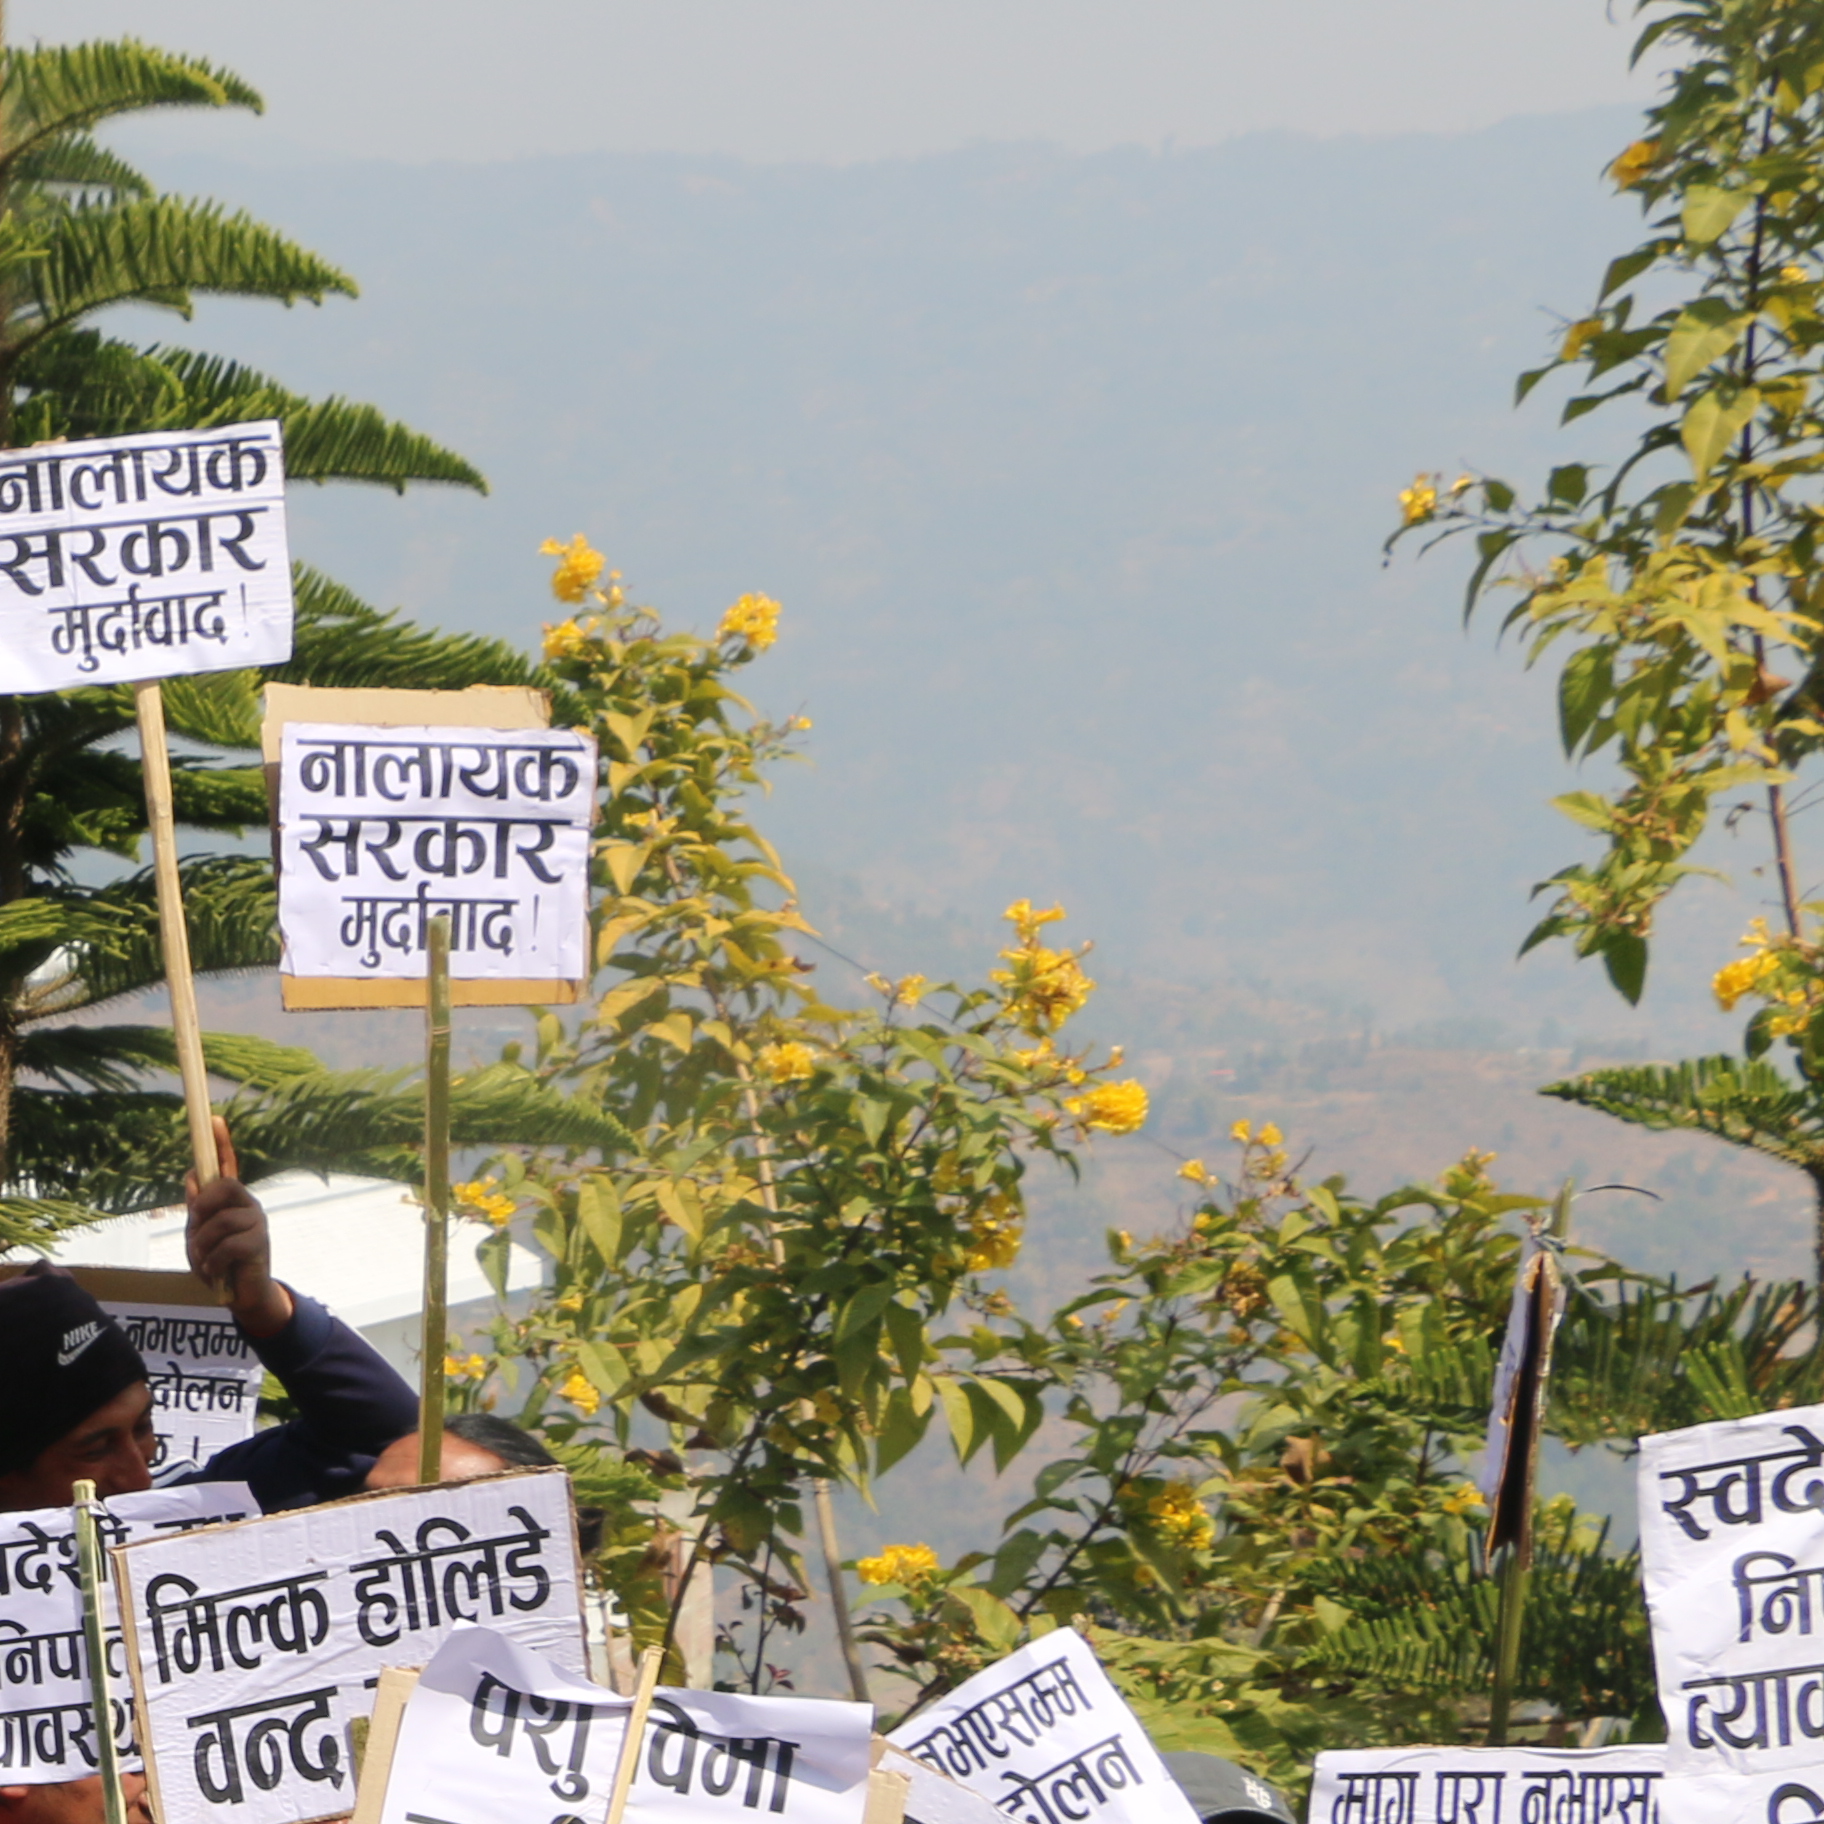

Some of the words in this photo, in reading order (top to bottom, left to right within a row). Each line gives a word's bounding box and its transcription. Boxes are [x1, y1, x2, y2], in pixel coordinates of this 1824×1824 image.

[296, 738, 585, 802] नालायक
[297, 811, 573, 884] सरकार
[63, 1321, 99, 1350] NIKE
[145, 1573, 330, 1684] मिल्क
[349, 1505, 551, 1647] होलिडे
[187, 1685, 346, 1805] वन्द
[469, 1670, 593, 1802] पशु
